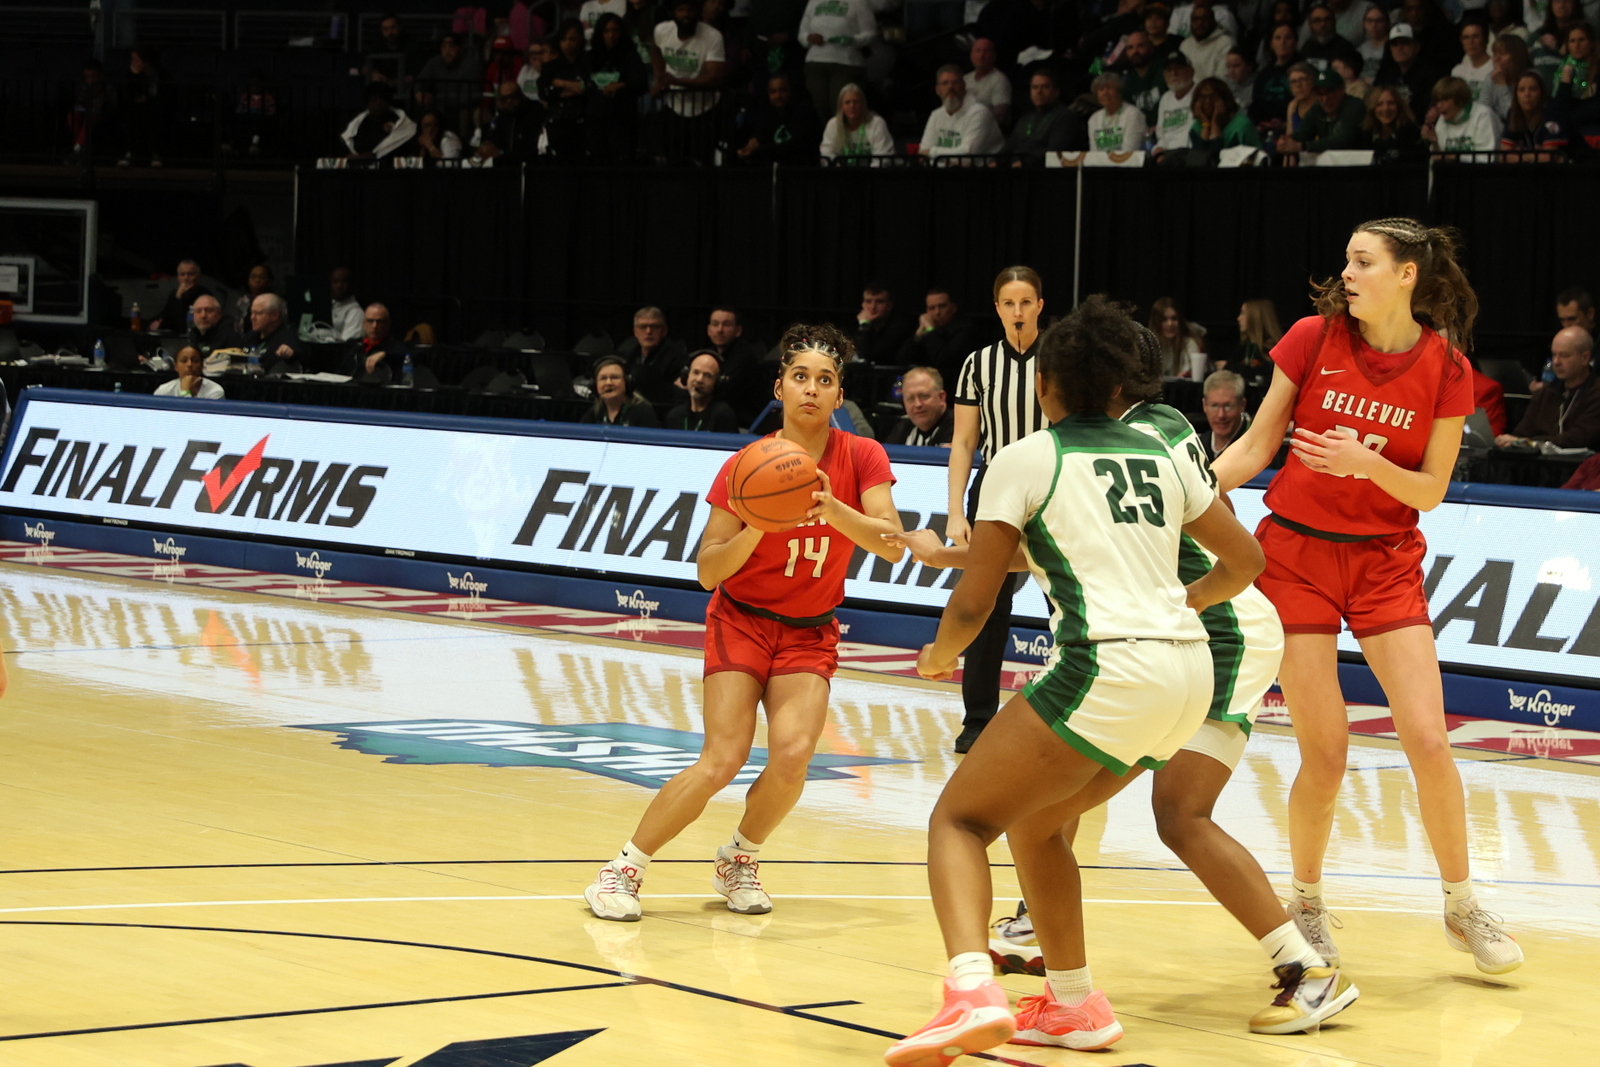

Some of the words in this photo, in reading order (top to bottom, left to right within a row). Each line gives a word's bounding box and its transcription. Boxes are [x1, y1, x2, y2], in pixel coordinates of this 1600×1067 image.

[1321, 389, 1416, 431] BELLEVUE
[0, 427, 388, 528] FINALFORMS
[1092, 458, 1166, 528] 25
[33, 522, 56, 545] Kroger
[163, 537, 187, 560] Kroger
[306, 551, 332, 578] Kroger
[784, 536, 830, 578] 14
[459, 571, 488, 597] Kroger
[629, 589, 660, 617] Kroger
[1527, 689, 1575, 726] Kroger
